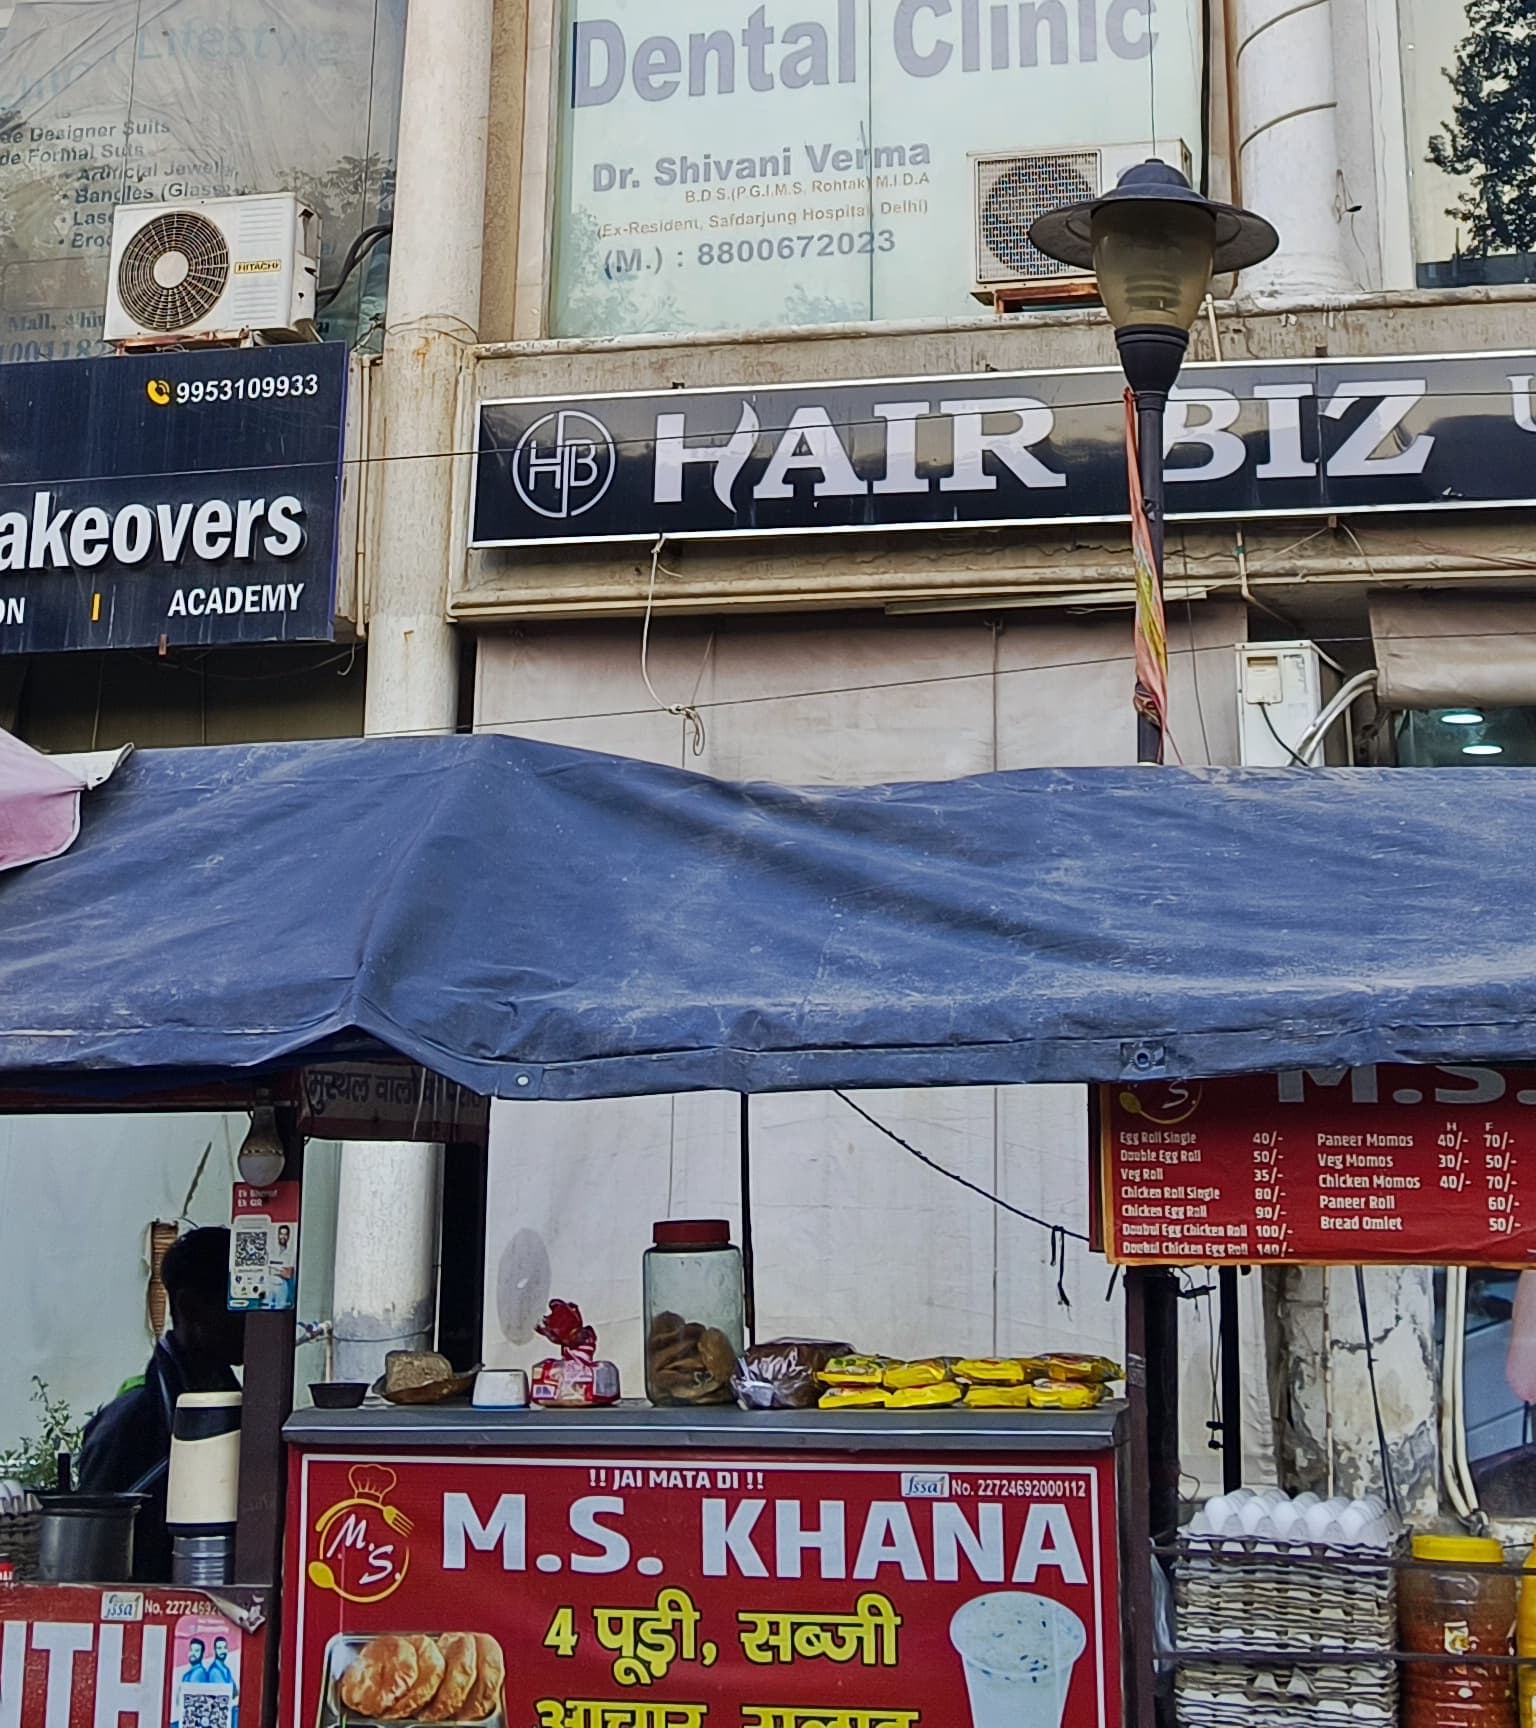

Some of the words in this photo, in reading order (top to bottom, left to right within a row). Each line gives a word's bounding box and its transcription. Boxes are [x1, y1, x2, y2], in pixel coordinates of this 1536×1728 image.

[593, 163, 640, 192] Dr.
[654, 146, 793, 187] Shivani
[804, 141, 931, 174] Verma
[697, 229, 896, 266] 8800672023
[175, 373, 320, 404] 9953109933
[654, 395, 1067, 513] HAIR
[168, 582, 306, 619] ACADEMY
[1319, 1174, 1369, 1189] Chicken
[612, 1469, 643, 1490] JAI
[649, 1469, 712, 1489] MATA
[717, 1470, 739, 1489] DI
[952, 1479, 975, 1497] No.
[977, 1479, 1087, 1498] 22724692000112
[443, 1493, 664, 1576] M.S.
[702, 1497, 1089, 1584] KHANA
